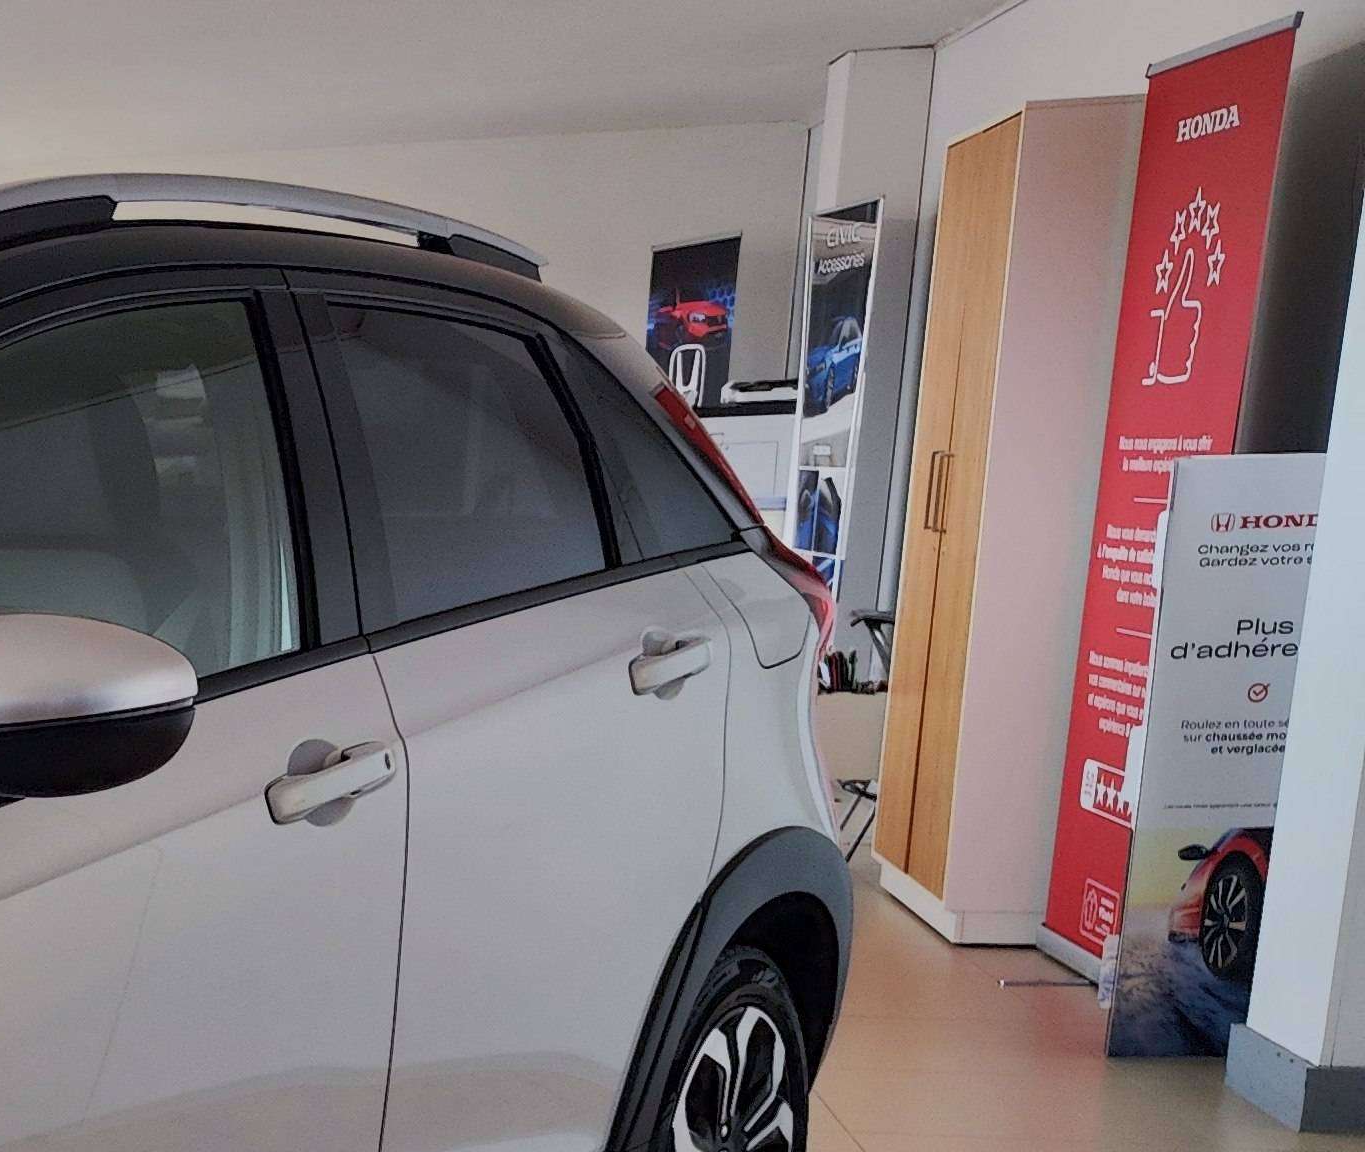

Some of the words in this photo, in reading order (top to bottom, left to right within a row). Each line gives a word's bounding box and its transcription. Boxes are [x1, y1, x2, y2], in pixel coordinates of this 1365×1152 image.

[1176, 104, 1240, 142] HONDA
[1197, 544, 1269, 556] Changez
[1272, 543, 1301, 554] vos
[1199, 556, 1257, 568] Gardez
[1261, 555, 1304, 566] votre
[1236, 618, 1294, 636] Plus
[1170, 637, 1299, 660] d'adhére
[1180, 719, 1221, 730] Roulez
[1224, 720, 1240, 729] en
[1183, 733, 1202, 742] sur
[1205, 731, 1263, 742] chaussée
[1211, 745, 1223, 755] et
